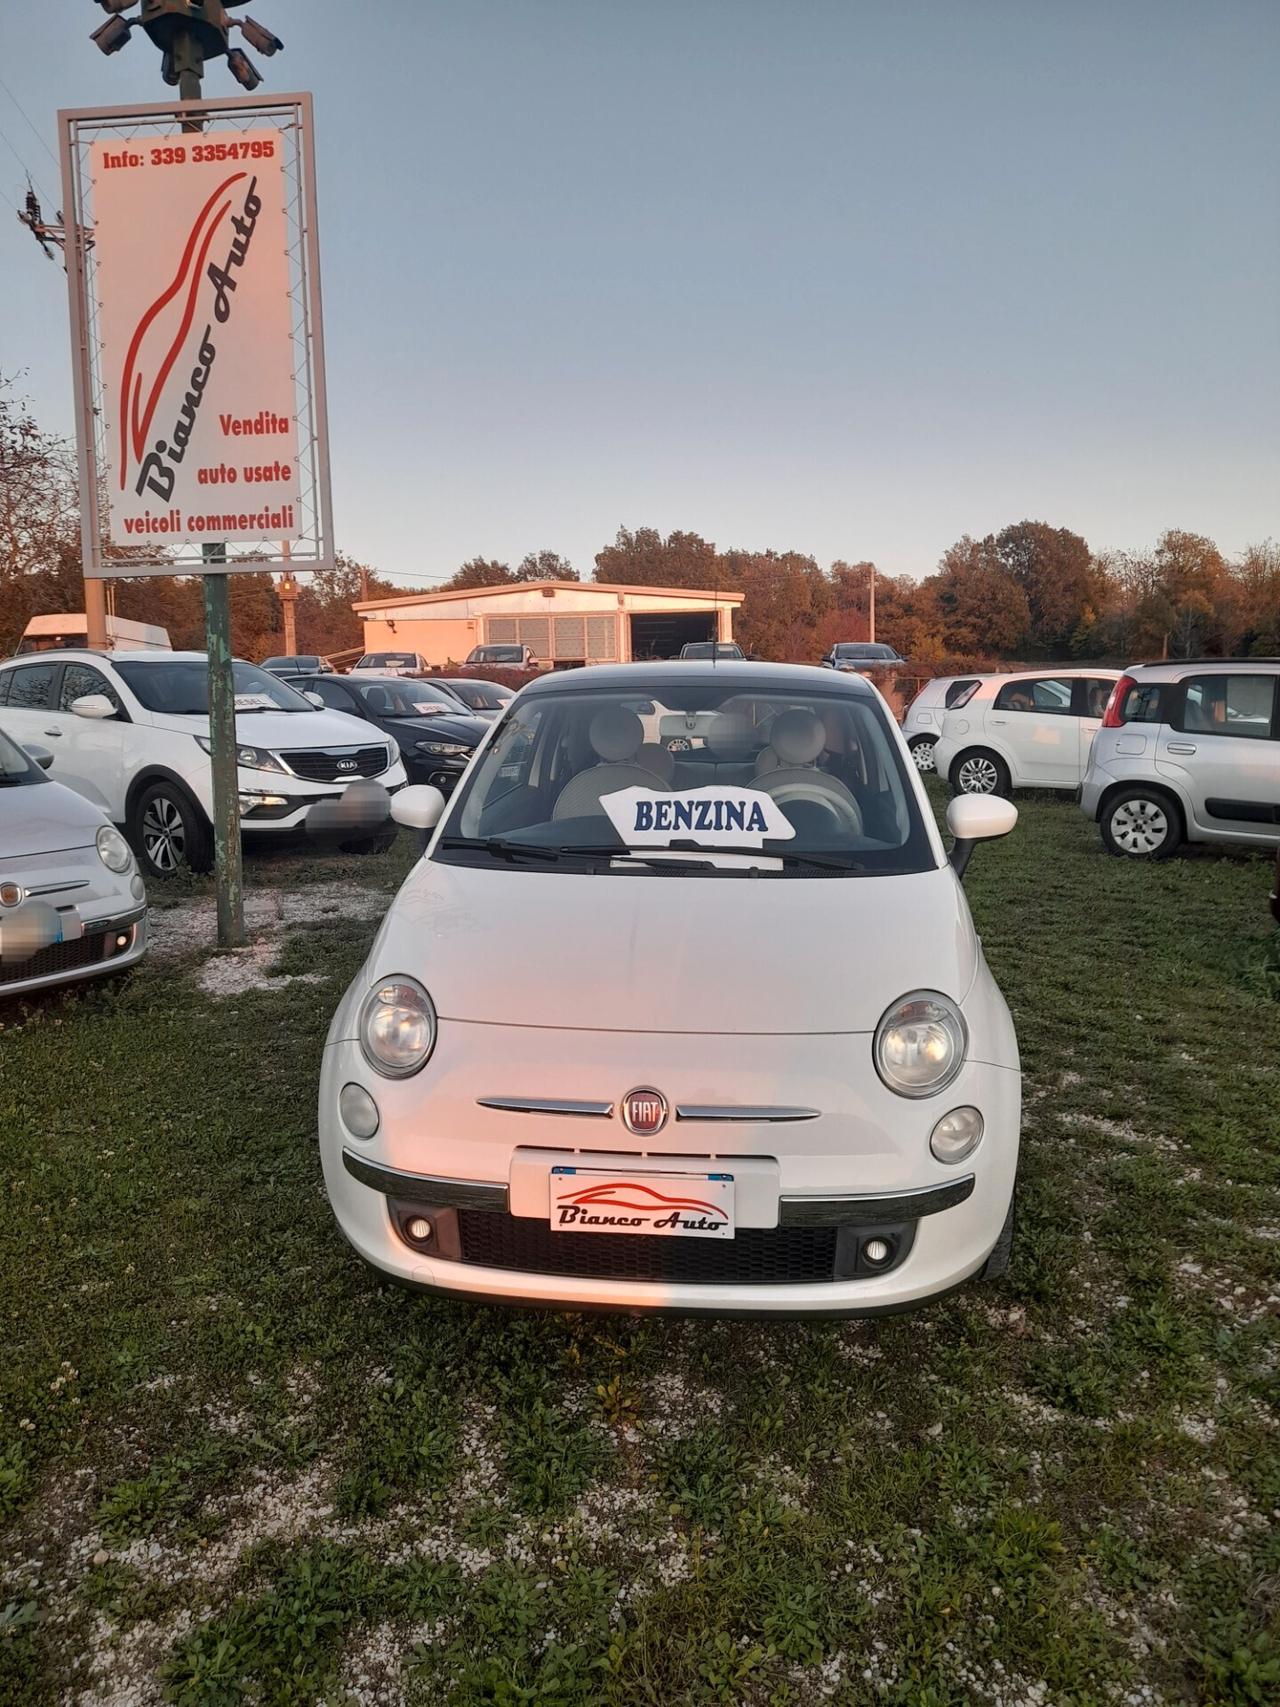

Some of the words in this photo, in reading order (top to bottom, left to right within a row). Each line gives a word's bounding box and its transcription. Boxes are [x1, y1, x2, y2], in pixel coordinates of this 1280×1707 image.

[102, 149, 144, 169] Info:
[151, 146, 186, 166] 339
[192, 140, 274, 163] 3354795
[134, 323, 216, 503] Bianco
[207, 175, 262, 323] Auto
[219, 411, 289, 437] Vendita
[197, 463, 237, 485] auto
[243, 460, 291, 483] usate
[123, 509, 181, 534] veicoli
[187, 504, 294, 532] commerciali
[340, 761, 355, 769] KIA
[633, 800, 768, 832] BENZINA
[631, 1101, 659, 1123] FIAT
[556, 1204, 651, 1227] Bianco
[653, 1211, 728, 1231] Auto
